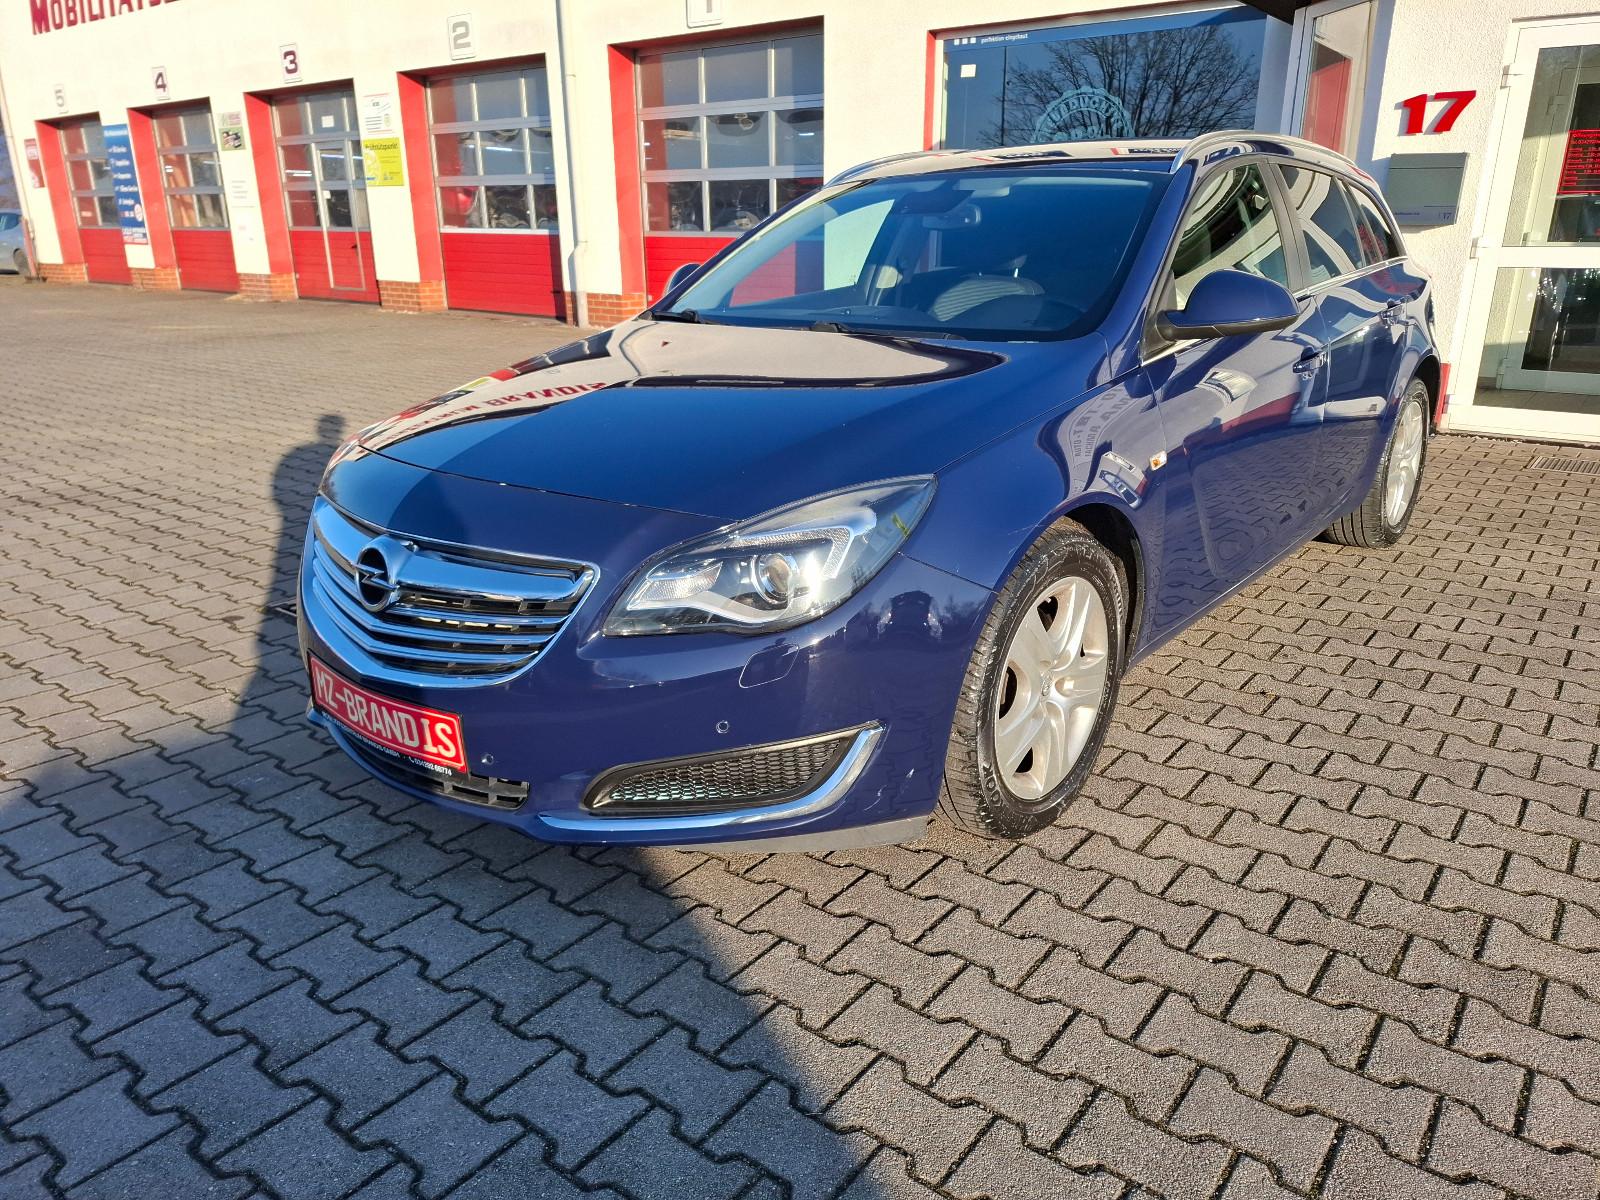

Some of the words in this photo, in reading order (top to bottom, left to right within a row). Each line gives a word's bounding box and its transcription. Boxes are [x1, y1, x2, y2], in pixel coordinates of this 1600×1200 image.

[451, 20, 471, 49] 2
[283, 50, 298, 75] 3
[154, 71, 168, 93] 4
[55, 89, 65, 107] 5
[1403, 90, 1476, 135] 17
[315, 667, 457, 758] MZ-BRANDIS
